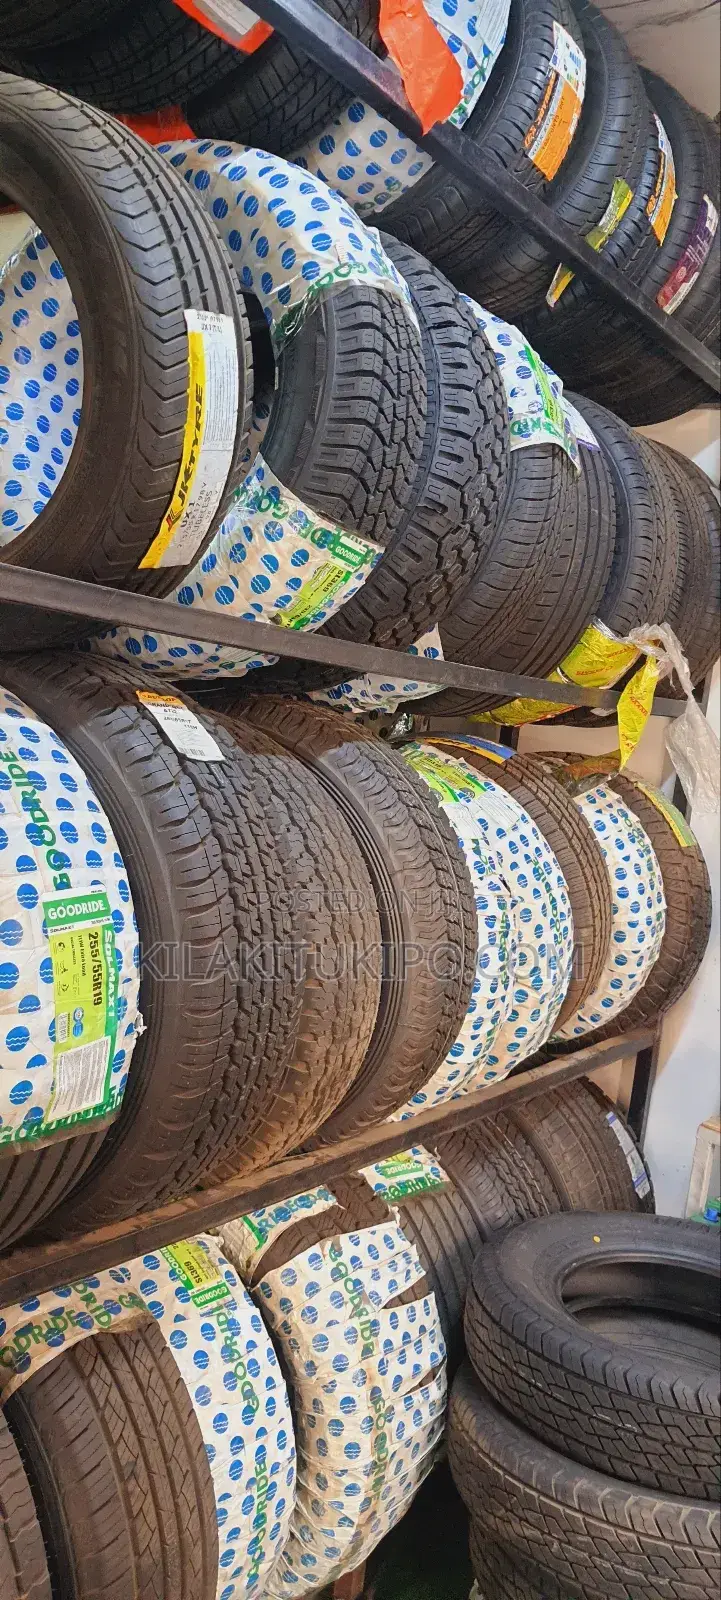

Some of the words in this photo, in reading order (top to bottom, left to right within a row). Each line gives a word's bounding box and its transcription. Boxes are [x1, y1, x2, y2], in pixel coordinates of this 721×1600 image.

[47, 898, 107, 920] GOODRIDE
[88, 931, 103, 1007] 255/55R19
[104, 929, 117, 1008] SOLMAX
